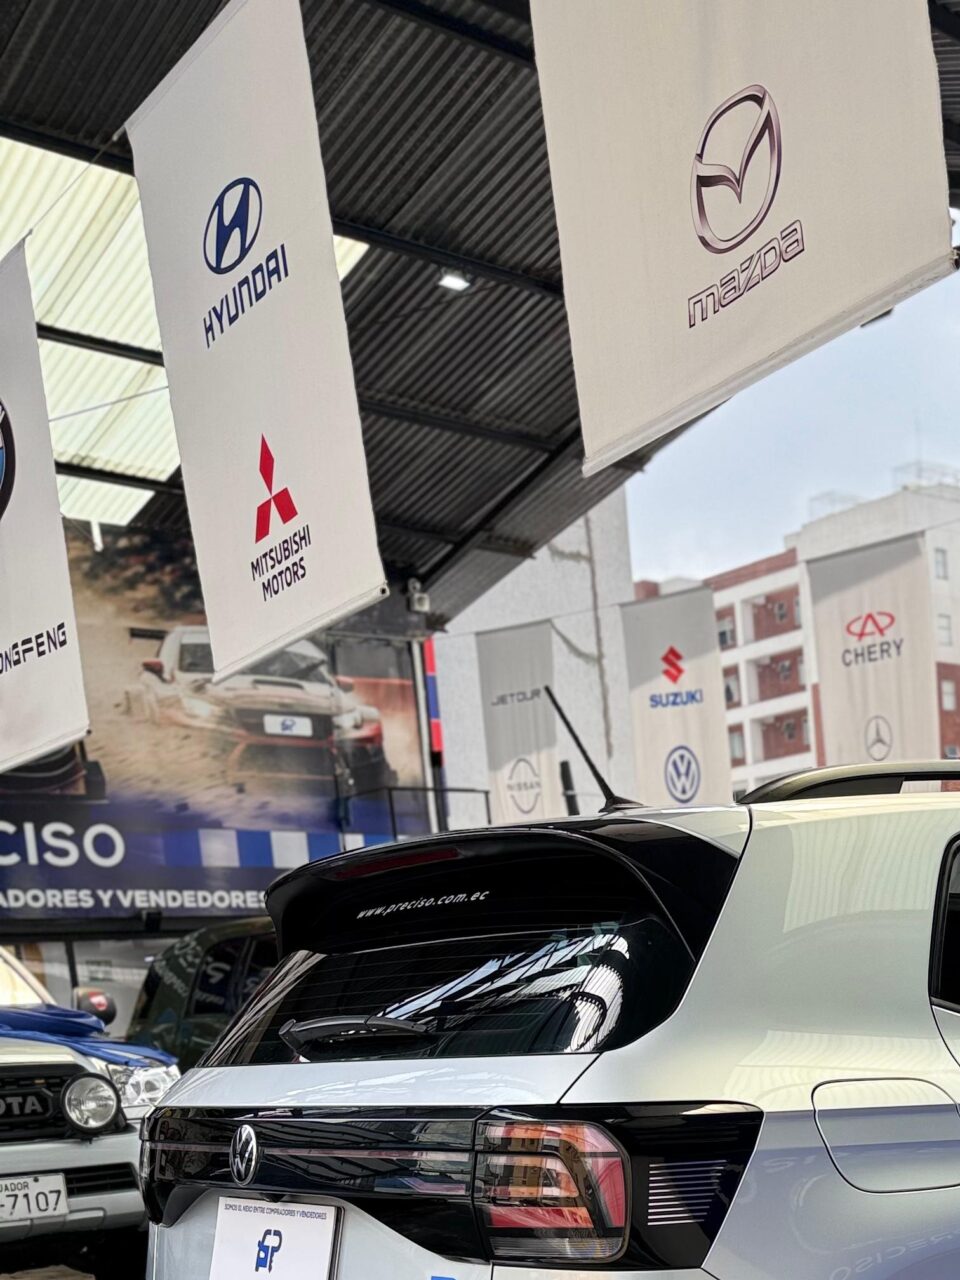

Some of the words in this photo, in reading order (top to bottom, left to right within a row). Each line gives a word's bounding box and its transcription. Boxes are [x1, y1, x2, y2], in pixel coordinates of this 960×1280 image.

[203, 243, 289, 349] HYUNDAI
[250, 524, 311, 581] MITSUBISHI
[262, 556, 306, 602] MOTORS
[841, 638, 904, 667] CHERY
[490, 689, 542, 706] JETOUR
[649, 688, 704, 708] SUZUKI
[506, 781, 542, 792] NISSAN
[97, 889, 114, 909] Y
[356, 890, 490, 920] www.preciso.com.ec
